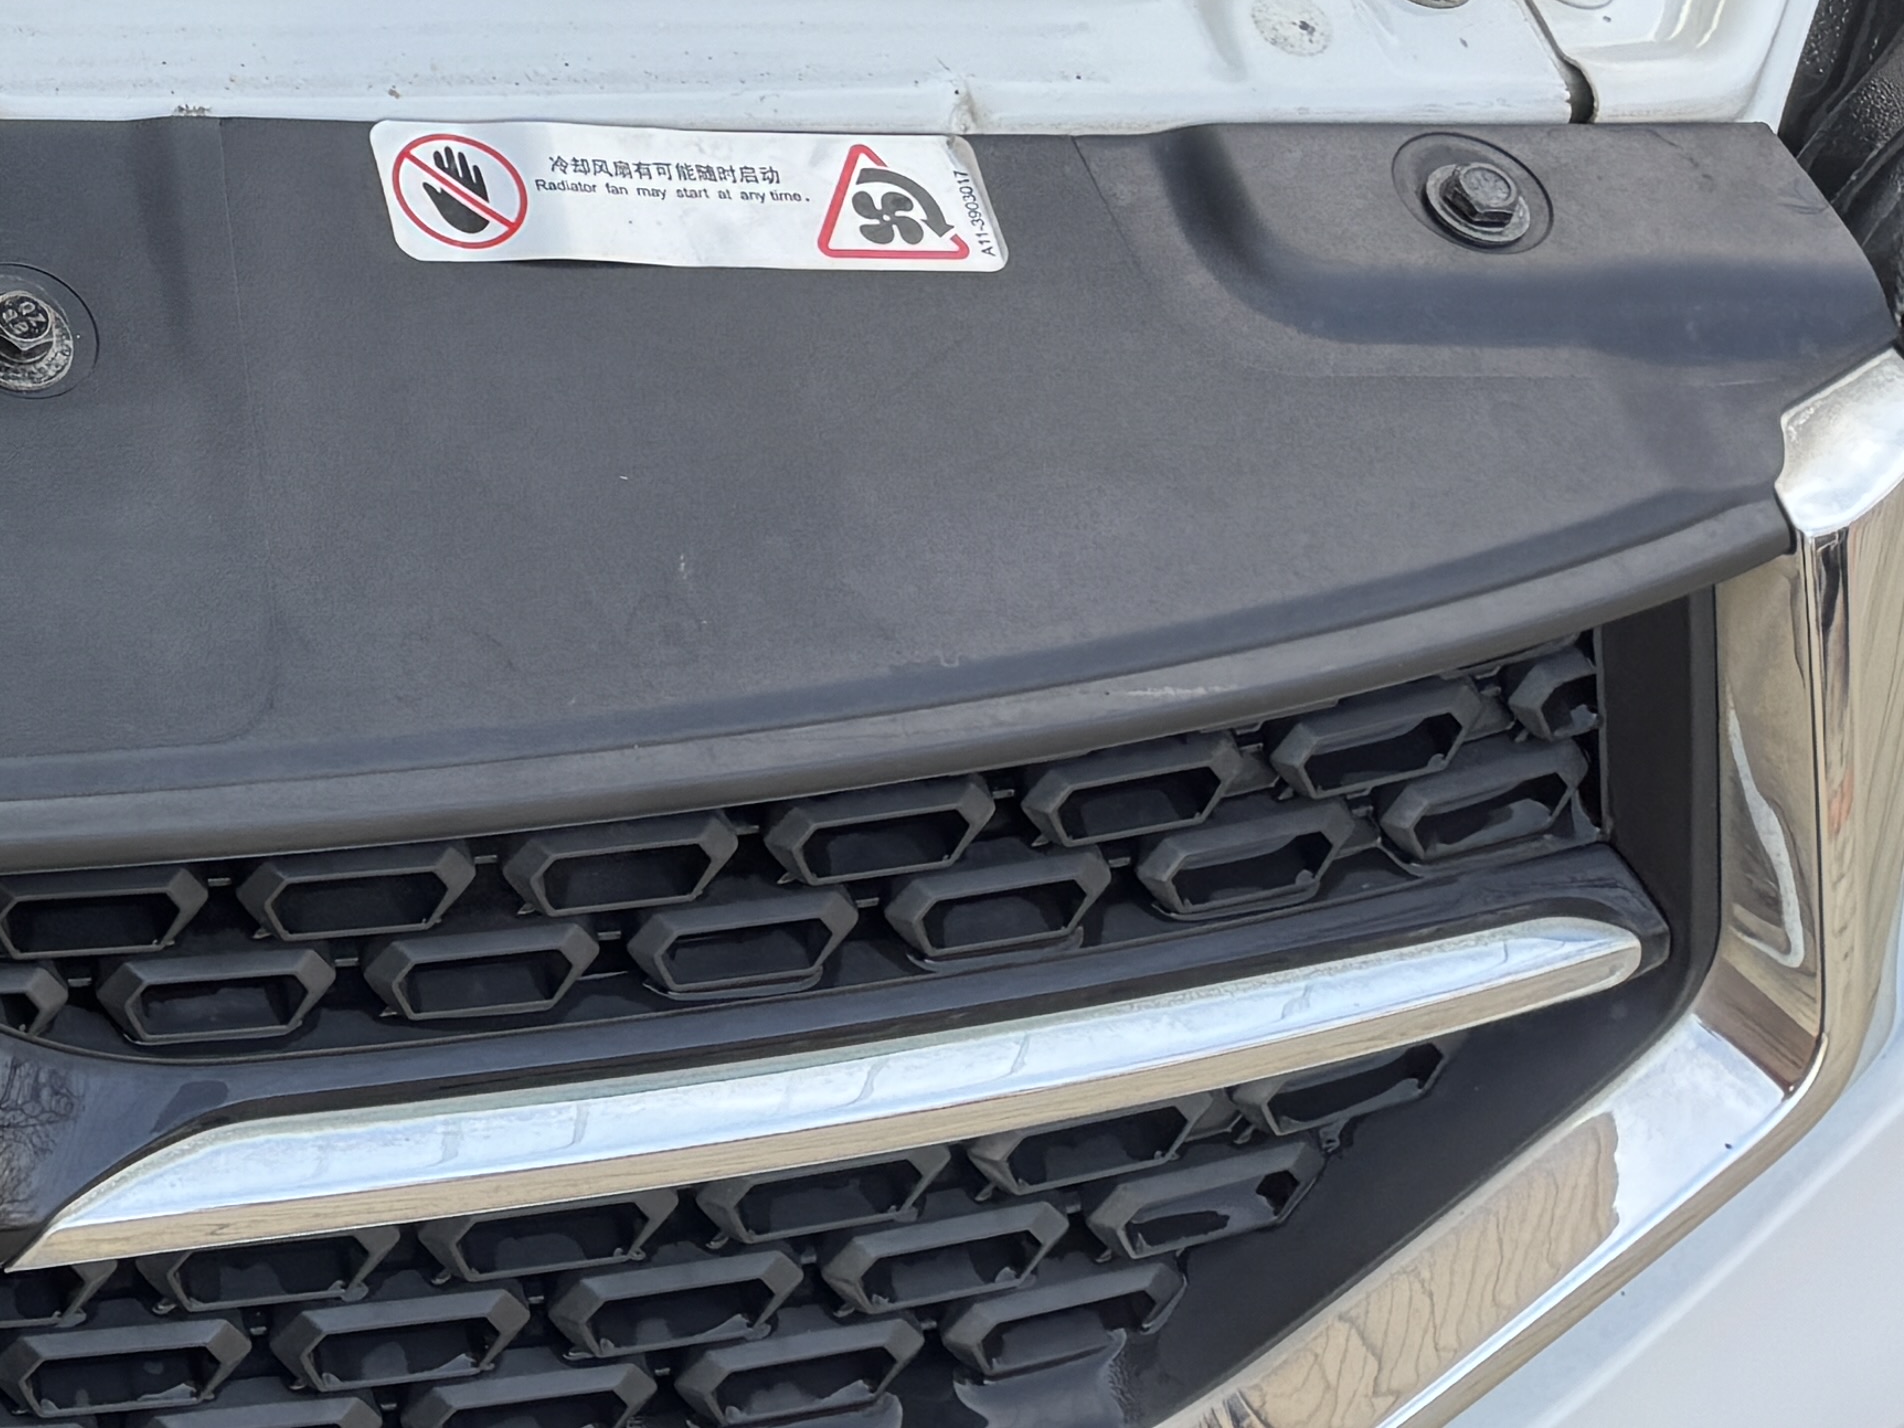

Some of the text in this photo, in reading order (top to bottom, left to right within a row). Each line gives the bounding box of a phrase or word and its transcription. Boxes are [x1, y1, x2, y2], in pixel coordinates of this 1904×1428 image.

[548, 155, 780, 185] 冷却风扇有可能随时启动
[534, 179, 811, 204] Radiator fan may start at any time.
[953, 170, 996, 257] A11-3903017
